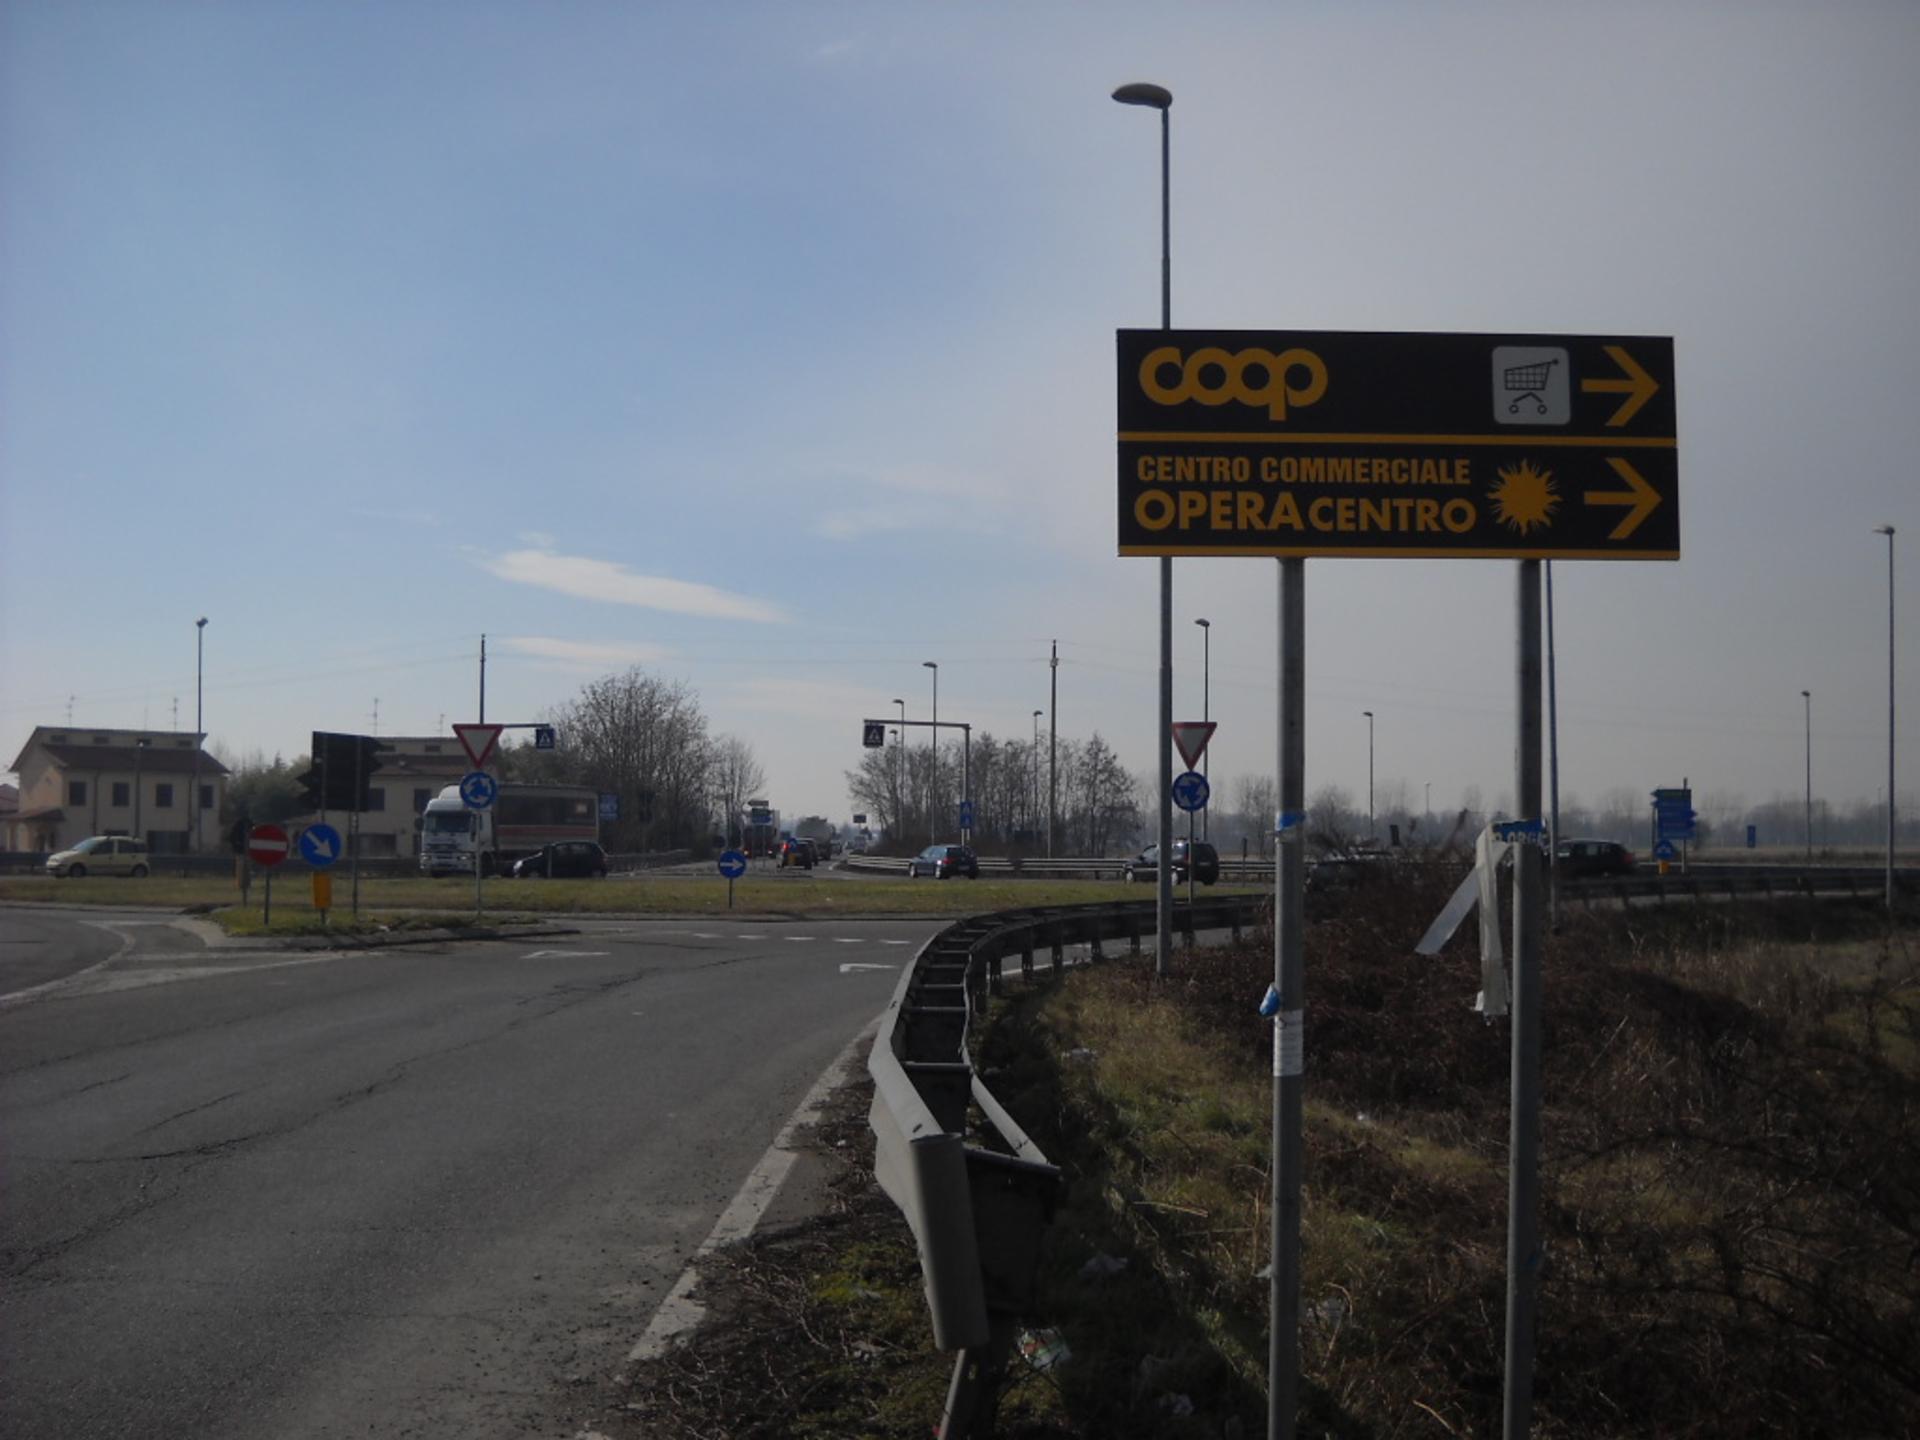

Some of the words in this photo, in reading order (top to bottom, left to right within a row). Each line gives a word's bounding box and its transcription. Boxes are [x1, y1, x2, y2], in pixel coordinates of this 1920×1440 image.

[1139, 346, 1328, 421] coop
[1137, 455, 1250, 482] CENTRO
[1261, 457, 1471, 484] COMMERCIALE
